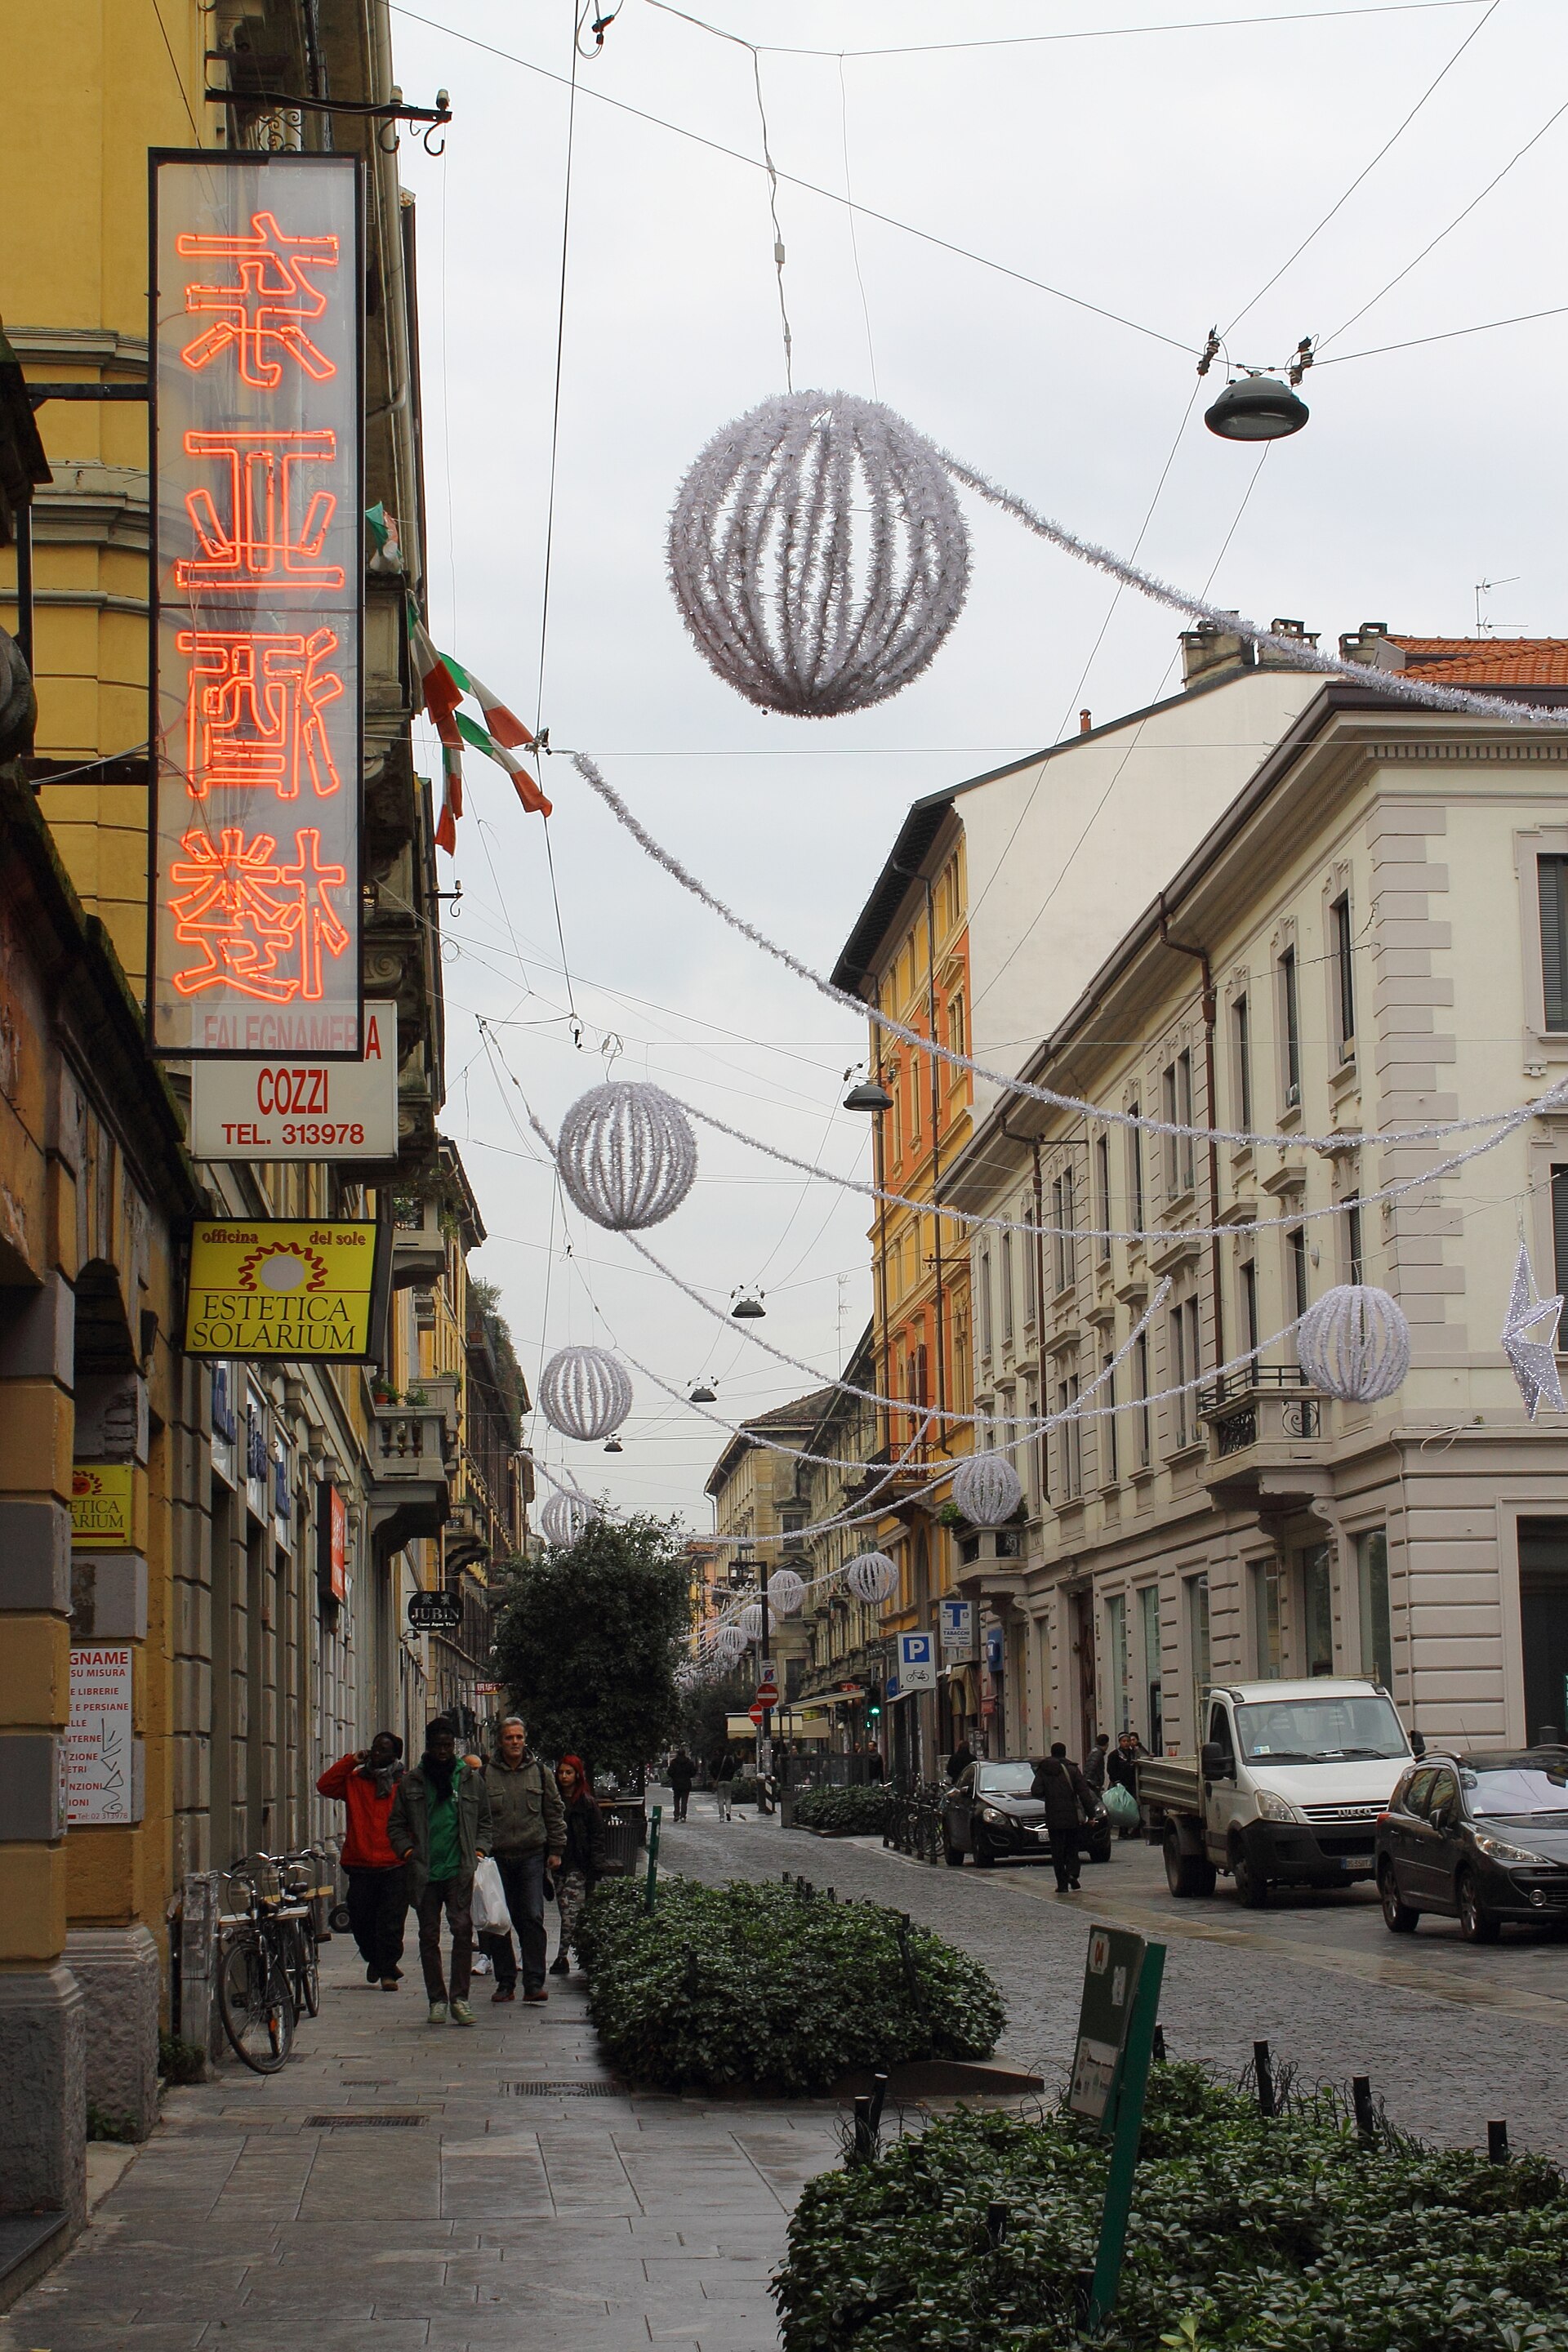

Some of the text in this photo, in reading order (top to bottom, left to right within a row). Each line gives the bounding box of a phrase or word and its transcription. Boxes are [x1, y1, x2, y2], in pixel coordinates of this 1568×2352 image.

[204, 1015, 382, 1060] FALEGNAMERA
[257, 1068, 328, 1116] COZZI
[221, 1124, 364, 1145] TEL. 313978
[202, 1229, 366, 1246] officina del sole
[203, 1294, 350, 1322] ESTETICA
[192, 1322, 356, 1350] SOLARIUM
[412, 1607, 460, 1620] JUBIN
[945, 1603, 968, 1627] T
[909, 1639, 924, 1660] P
[87, 1668, 126, 1677] MISURA
[78, 1687, 119, 1695] LIBRERIE
[83, 1703, 129, 1711] PERSIANE
[1338, 1808, 1372, 1817] IVECO
